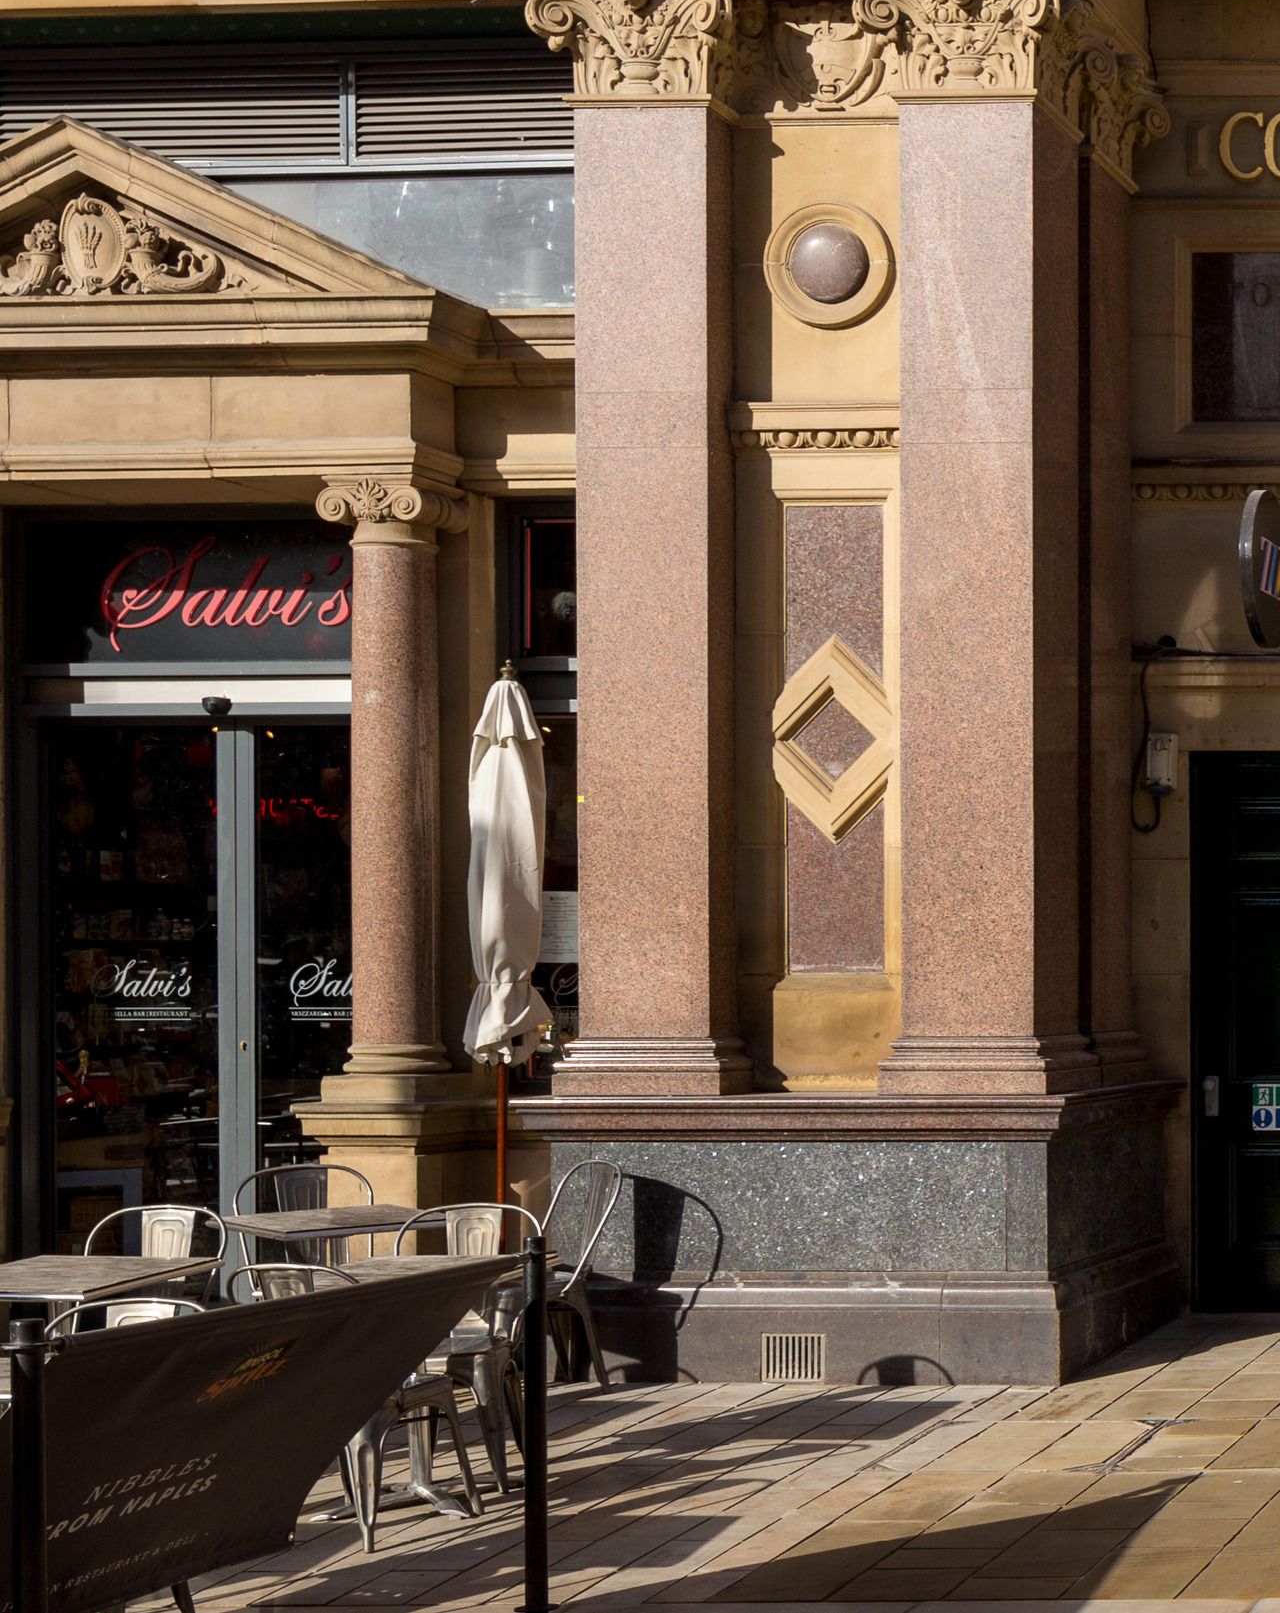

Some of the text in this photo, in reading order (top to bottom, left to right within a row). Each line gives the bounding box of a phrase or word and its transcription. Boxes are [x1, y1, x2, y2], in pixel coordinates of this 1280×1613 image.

[101, 537, 352, 652] Salvi's
[90, 959, 192, 998] Salvi's
[83, 1453, 218, 1505] NIBBLES
[119, 1474, 218, 1517] NAPLES
